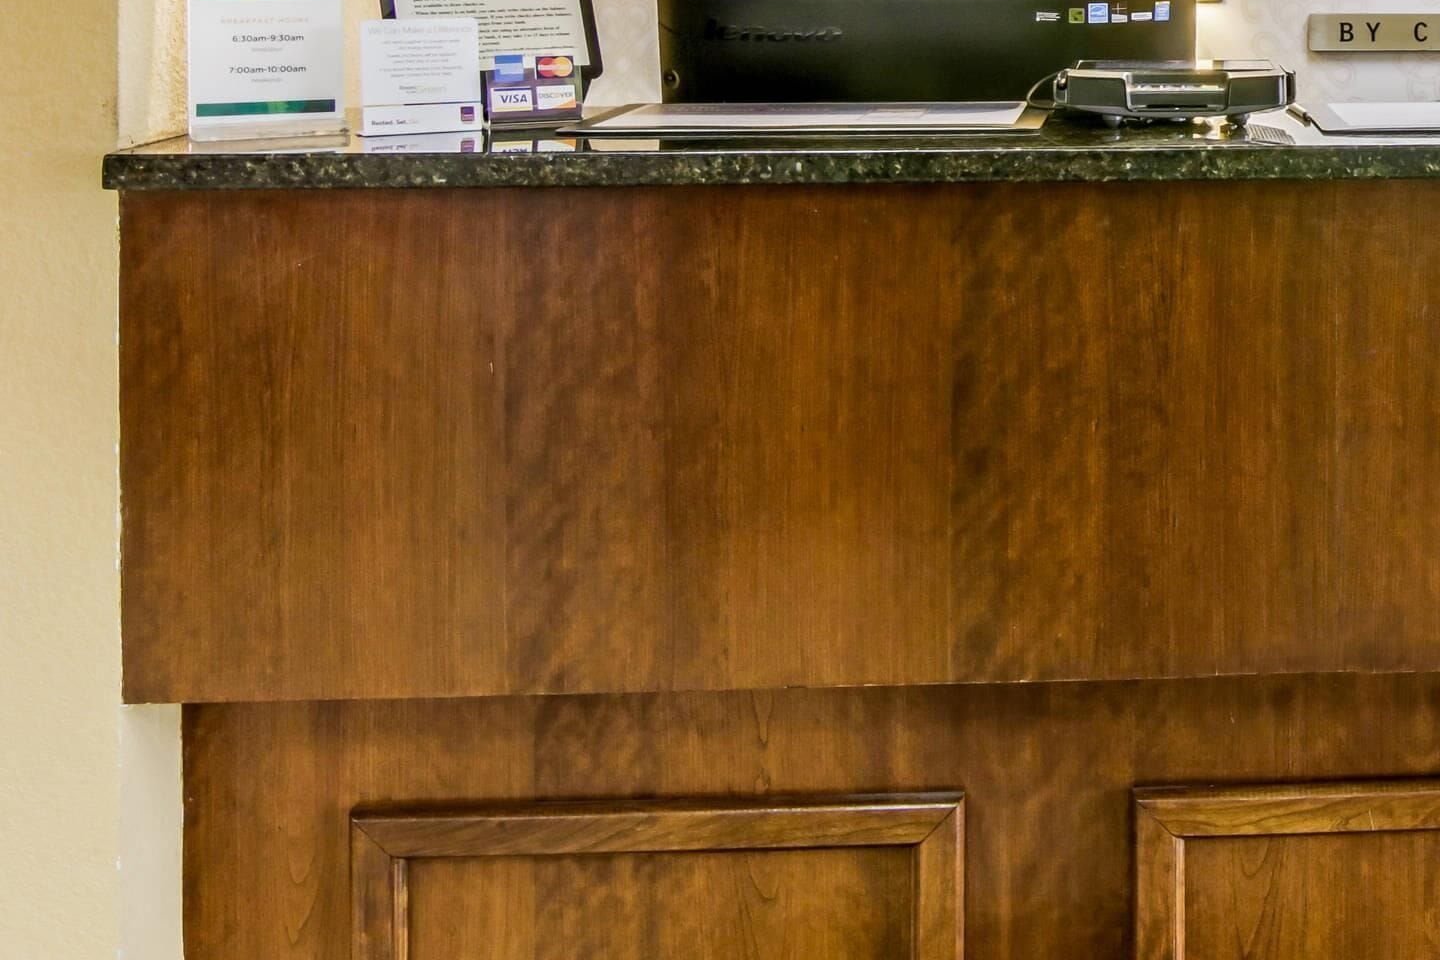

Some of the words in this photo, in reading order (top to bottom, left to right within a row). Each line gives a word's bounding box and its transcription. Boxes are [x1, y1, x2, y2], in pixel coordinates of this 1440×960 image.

[221, 16, 275, 24] BREAKFAST
[279, 16, 310, 24] HOURS
[705, 17, 842, 42] lenovo
[1339, 21, 1382, 43] BY
[232, 34, 304, 43] 6:30am-9:30am
[229, 65, 306, 74] 7:00am-10:00am
[500, 94, 528, 104] VISA
[538, 91, 573, 99] DISCOVER
